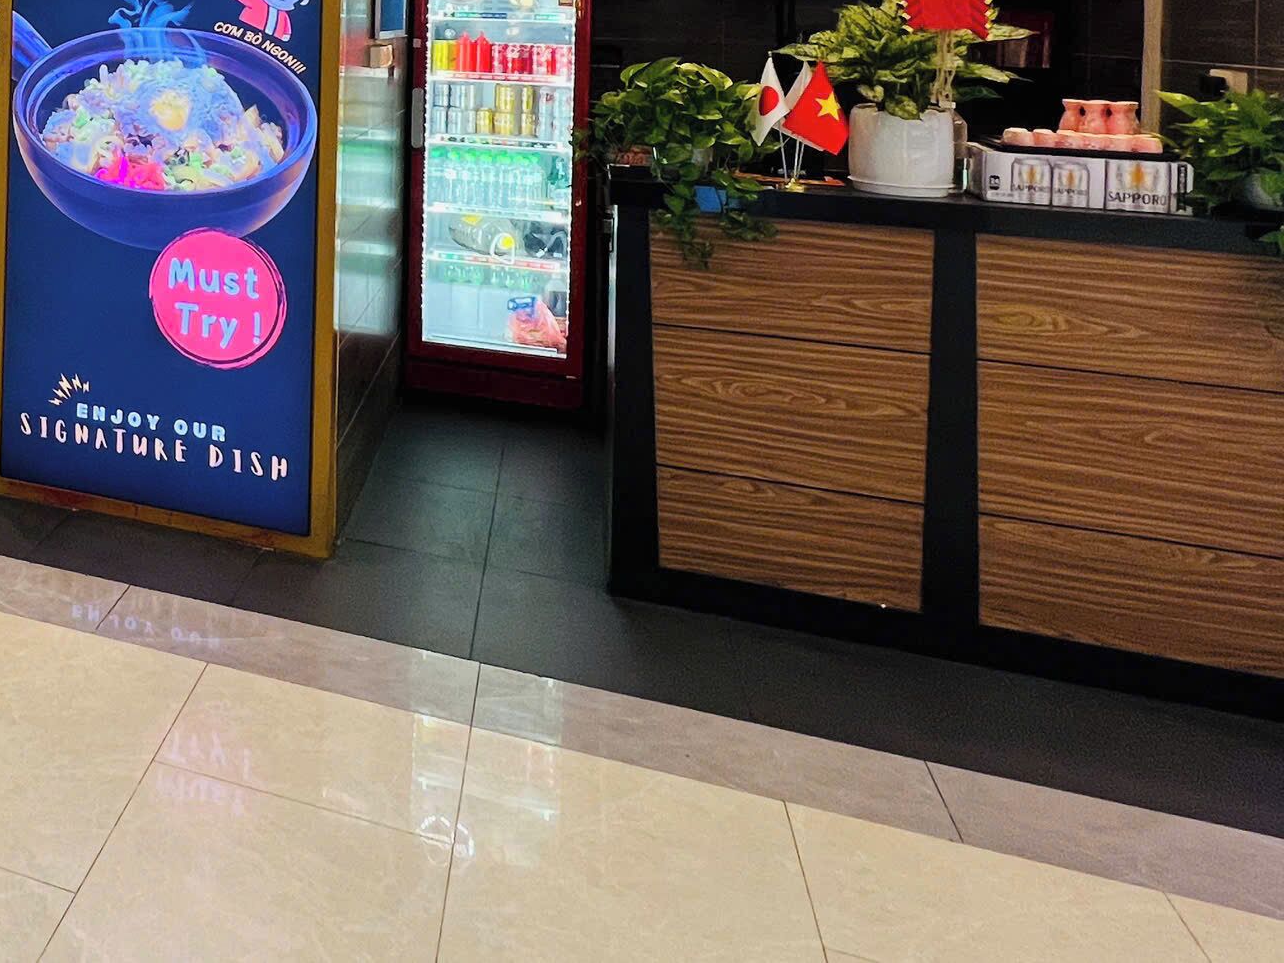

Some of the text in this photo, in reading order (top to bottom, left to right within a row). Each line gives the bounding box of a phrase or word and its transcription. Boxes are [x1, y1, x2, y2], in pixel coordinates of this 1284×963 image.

[214, 22, 244, 38] CƠM
[243, 31, 263, 45] BÒ
[1108, 190, 1166, 206] SAPPORO
[168, 257, 259, 300] Must
[174, 302, 238, 350] Try
[75, 402, 227, 442] ENJOY OUR
[19, 412, 290, 481] SIGNATURE DISH
